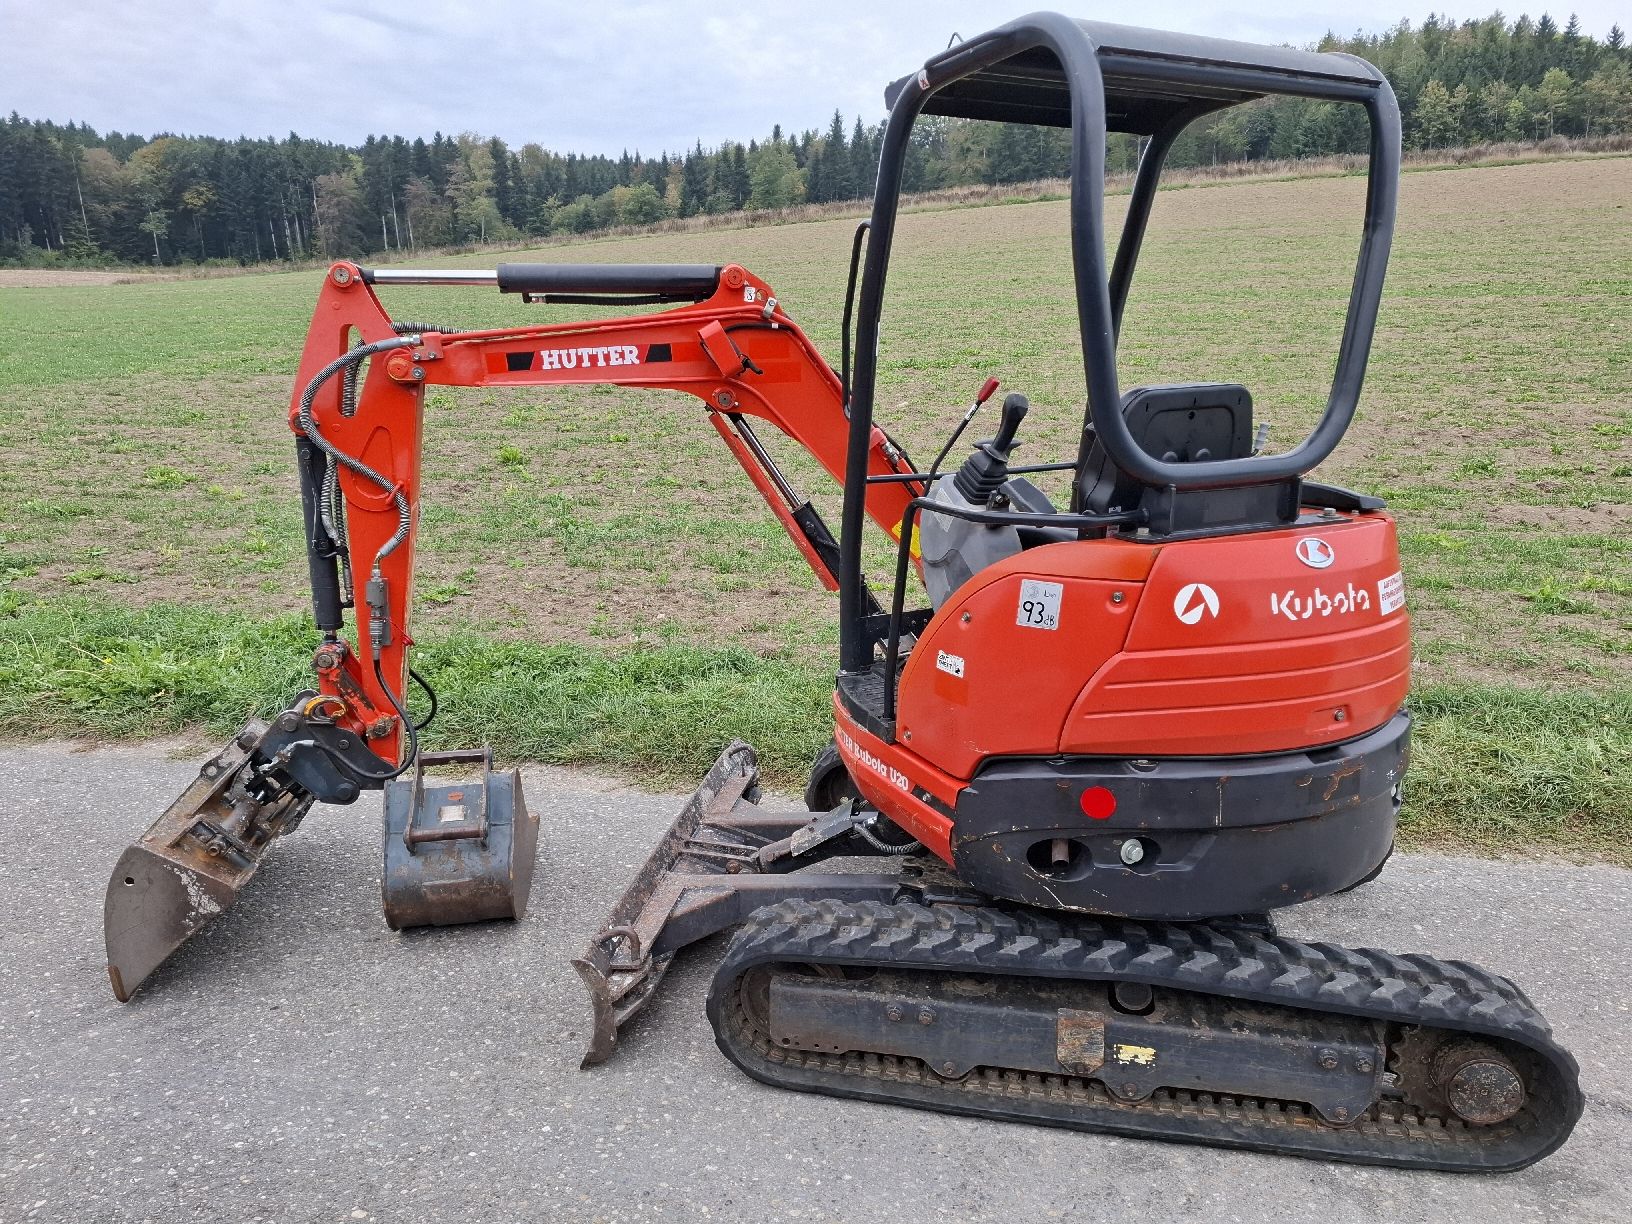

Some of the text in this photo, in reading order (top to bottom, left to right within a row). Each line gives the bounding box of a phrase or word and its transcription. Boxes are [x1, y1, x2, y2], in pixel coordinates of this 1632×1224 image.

[540, 345, 640, 370] HUTTER
[1022, 600, 1045, 624] 93
[1270, 582, 1371, 621] Kubota
[854, 742, 888, 777] Kubota
